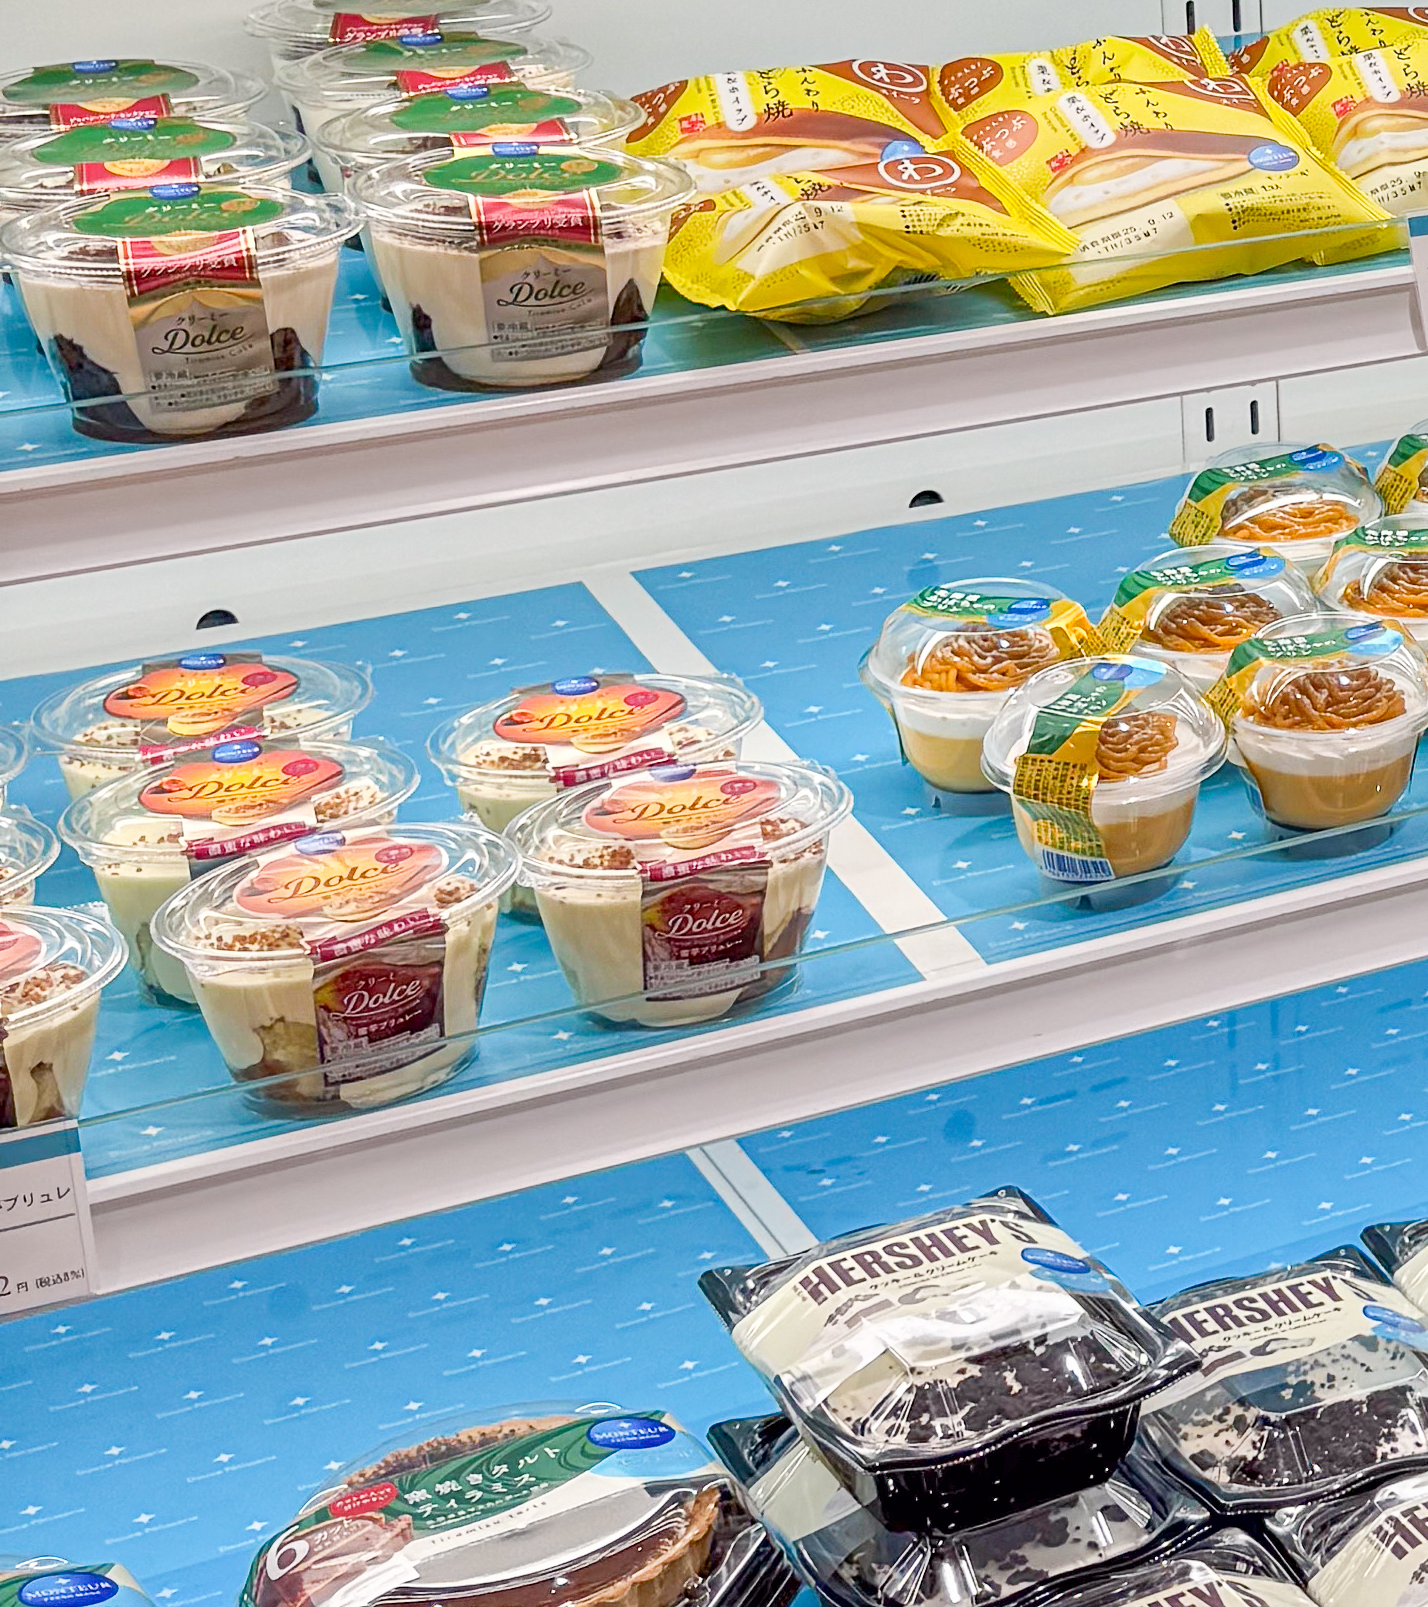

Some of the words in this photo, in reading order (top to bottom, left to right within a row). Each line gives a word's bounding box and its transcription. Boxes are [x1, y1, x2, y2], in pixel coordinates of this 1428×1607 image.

[1099, 88, 1151, 138] どら焼
[496, 278, 596, 308] Dolce
[152, 323, 254, 356] Dolce
[130, 684, 260, 711] Dolce
[525, 705, 648, 733] Dolce
[167, 774, 302, 804] Dolce
[613, 792, 743, 825] Dolce
[267, 860, 406, 904] Dolce
[654, 907, 745, 940] Dolce
[330, 977, 422, 1020] Dolce
[0, 1186, 71, 1212] ブリュレ
[799, 1214, 1041, 1307] HERSHEY'S
[417, 1471, 539, 1519] ティラミス
